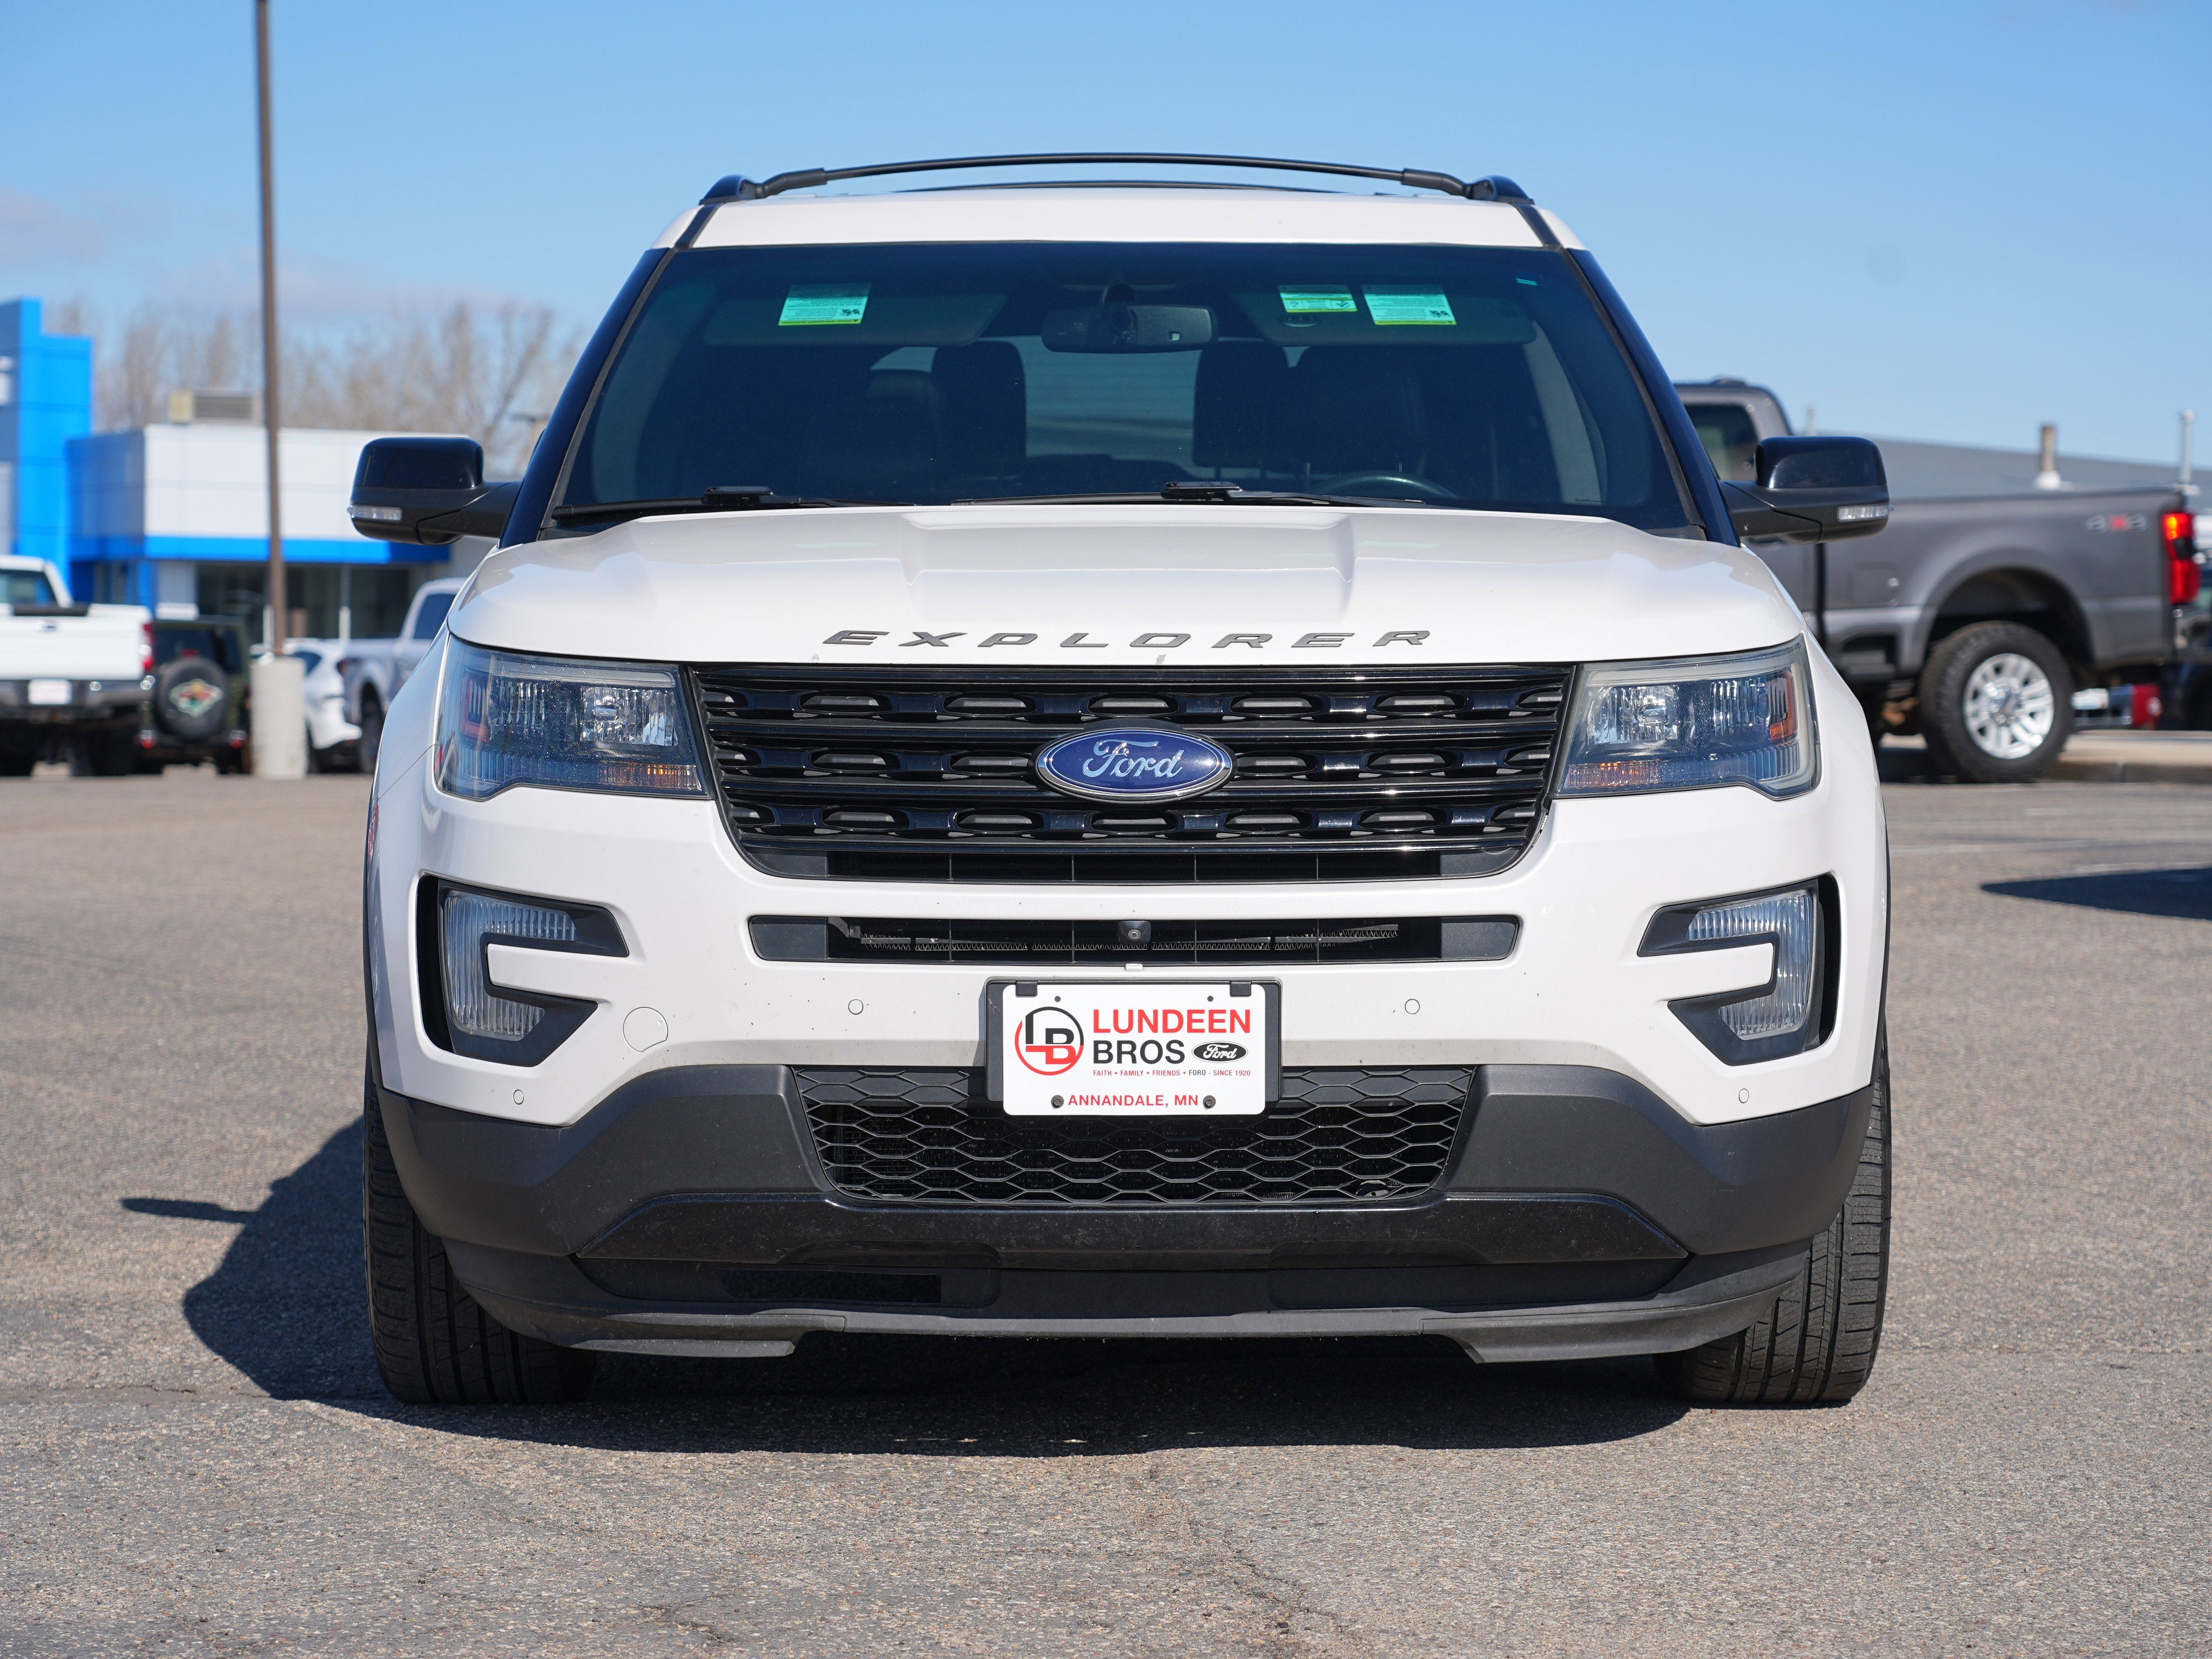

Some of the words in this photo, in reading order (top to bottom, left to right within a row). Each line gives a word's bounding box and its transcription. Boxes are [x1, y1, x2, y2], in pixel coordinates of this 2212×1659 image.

[822, 630, 1431, 649] EXPLORER
[1082, 739, 1185, 778] Ford
[1093, 1009, 1251, 1034] LUNDEEN
[1093, 1039, 1185, 1064] BROS
[1203, 1043, 1238, 1059] Ford
[1068, 1095, 1169, 1108] ANNANDALE,
[1174, 1095, 1199, 1107] MN
